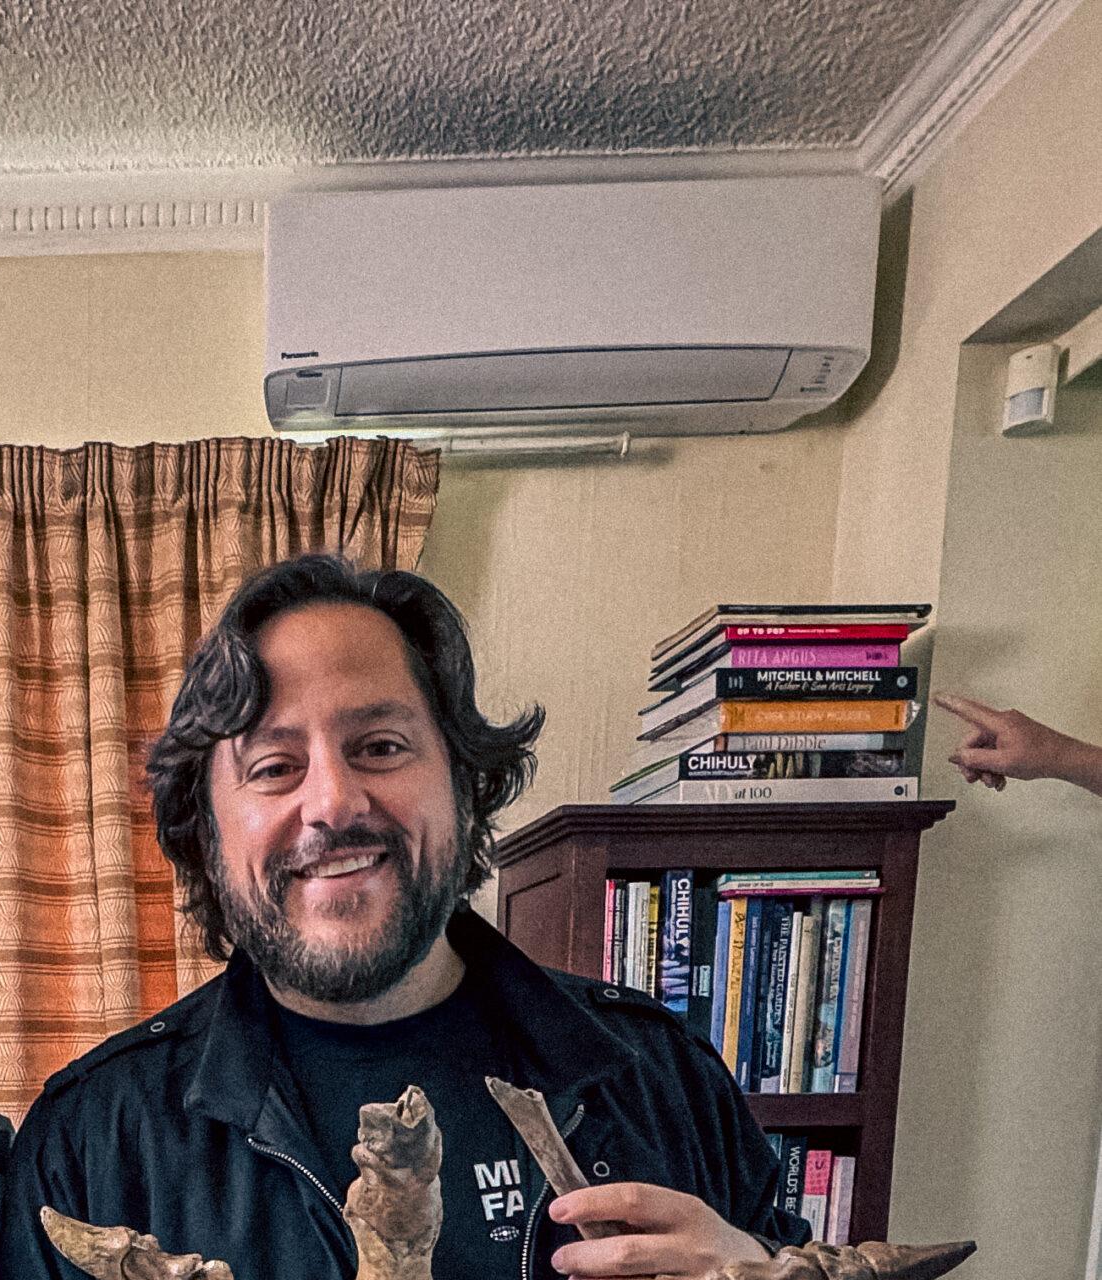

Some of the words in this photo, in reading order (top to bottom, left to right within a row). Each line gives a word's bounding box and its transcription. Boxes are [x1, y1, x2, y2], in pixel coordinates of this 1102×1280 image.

[752, 627, 765, 635] TO
[766, 627, 785, 635] POP
[738, 650, 768, 666] RITA
[771, 650, 817, 665] ANGUS
[757, 670, 812, 681] MITCHELL
[815, 670, 824, 681] &
[825, 670, 882, 681] MITCHELL
[778, 735, 827, 750] Dibble
[687, 754, 757, 771] CHIHULY
[734, 788, 746, 800] at
[750, 787, 773, 800] 100
[675, 878, 691, 945] CHIHULY
[779, 915, 790, 937] THE
[774, 983, 786, 1025] GARDEN
[473, 1160, 521, 1190] MI
[785, 1146, 802, 1194] WORLD'S
[481, 1190, 525, 1221] FA
